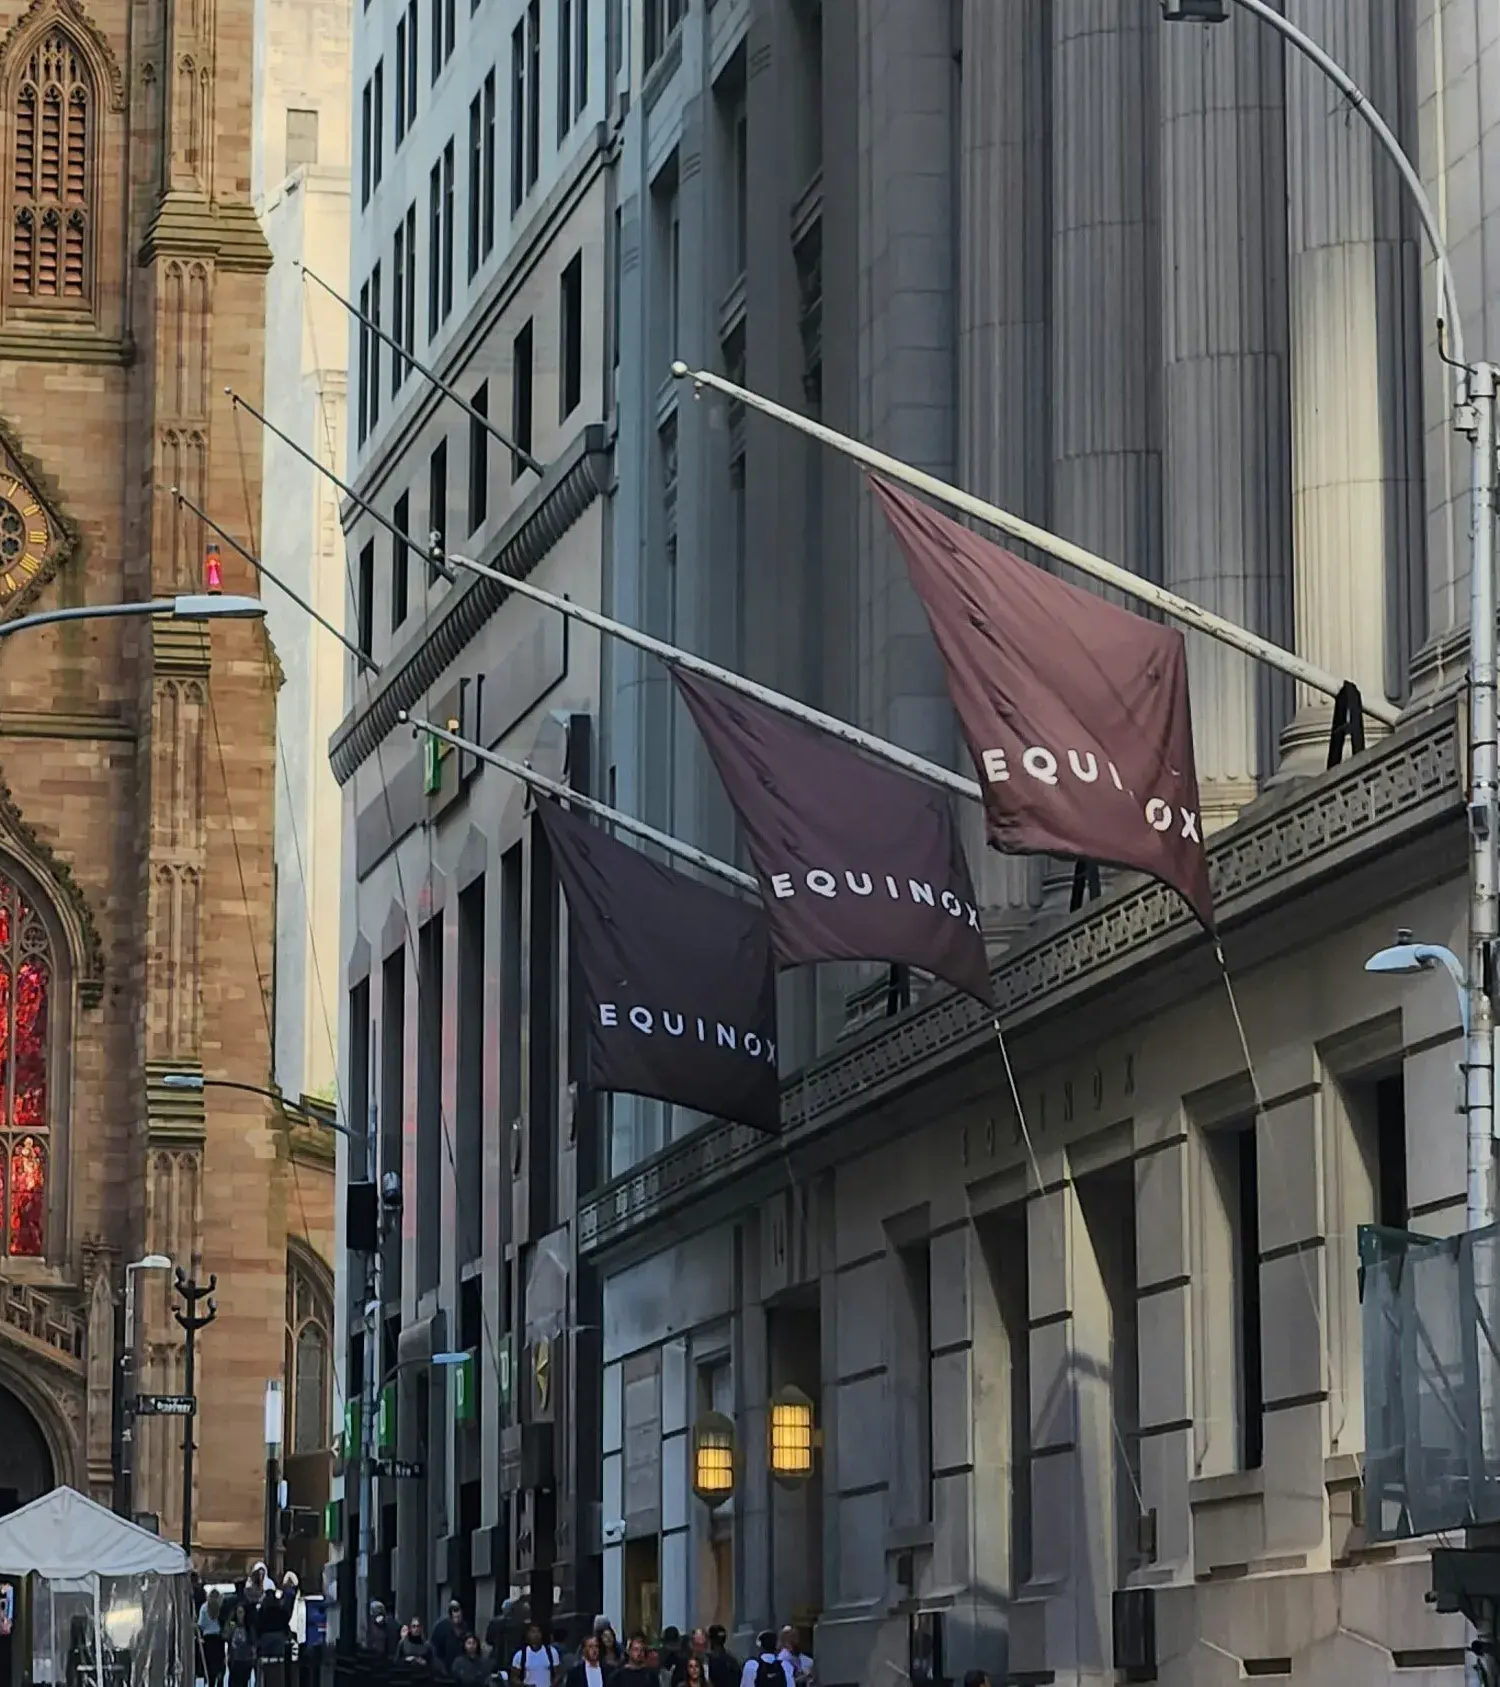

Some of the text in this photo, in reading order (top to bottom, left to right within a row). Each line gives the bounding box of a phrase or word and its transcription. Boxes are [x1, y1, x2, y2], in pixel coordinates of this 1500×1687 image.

[980, 746, 1200, 843] EQUIOX
[771, 869, 981, 932] EQUINOX
[599, 1003, 777, 1066] EQUINOX
